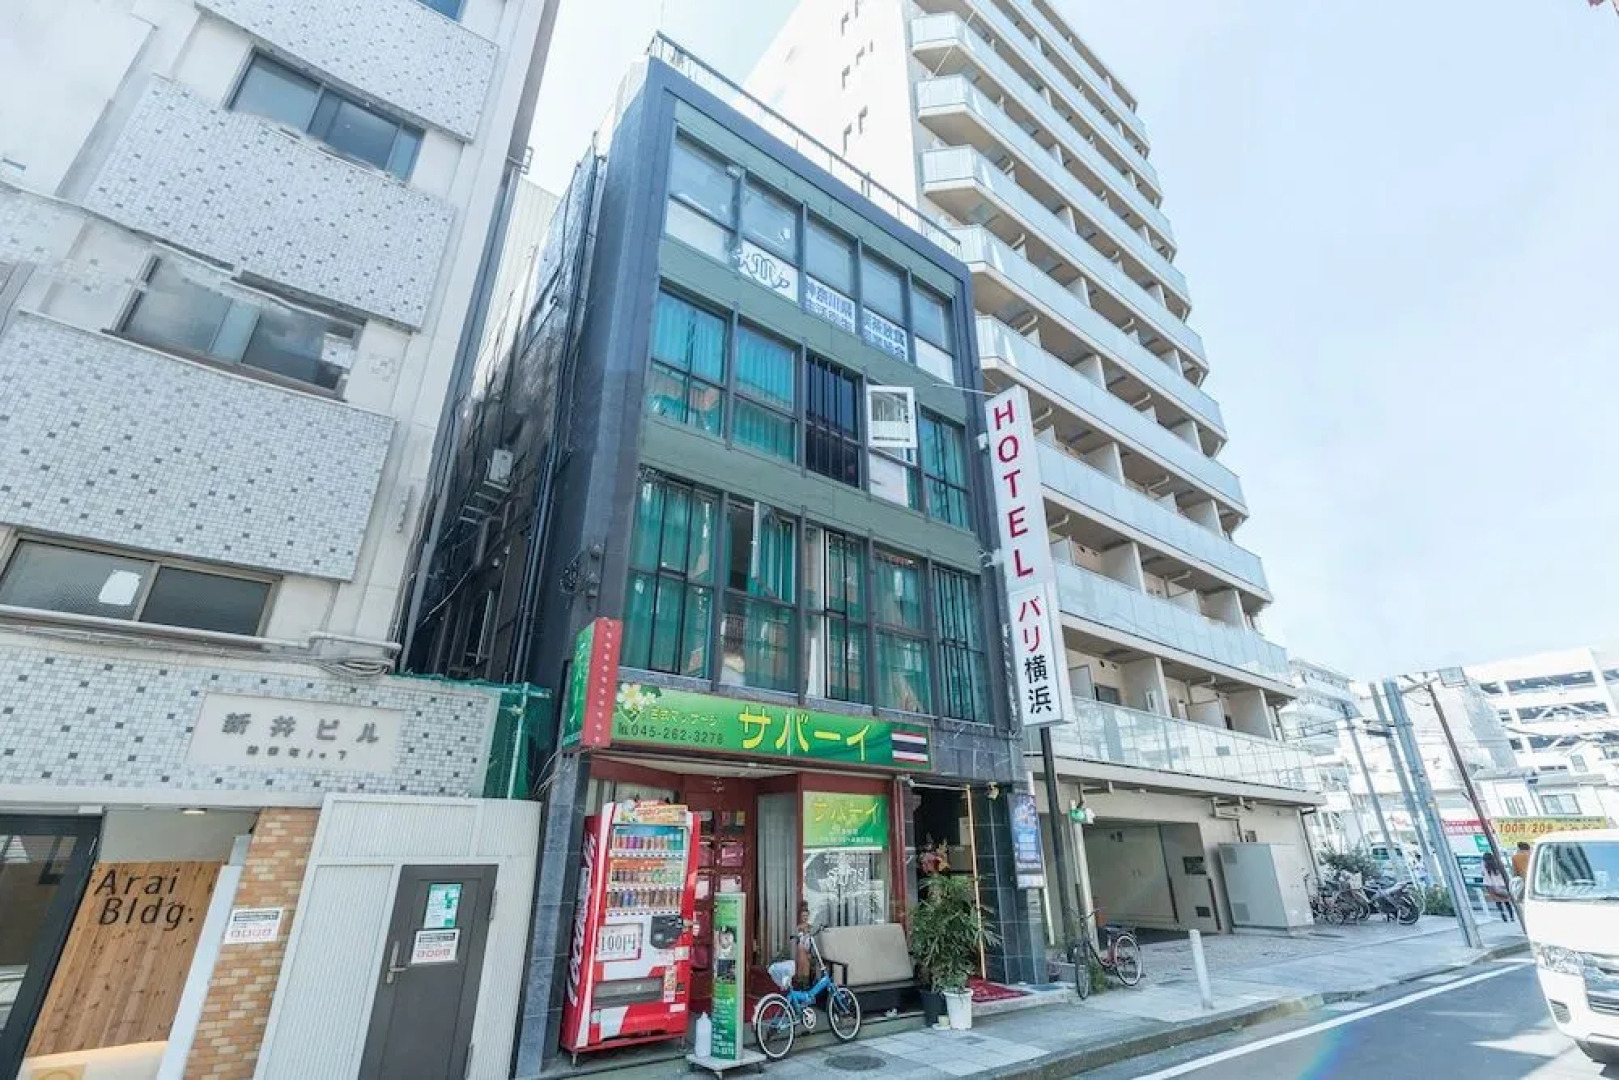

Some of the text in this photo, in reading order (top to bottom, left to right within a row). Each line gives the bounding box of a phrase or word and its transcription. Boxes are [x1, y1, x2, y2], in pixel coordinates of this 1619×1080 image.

[994, 399, 1053, 715] HOTEL バリ横浜
[221, 712, 380, 744] 新井ビル
[738, 705, 871, 762] サバーイ
[94, 867, 181, 897] Arai
[99, 897, 195, 932] Bldg.
[601, 933, 636, 950] 100円
